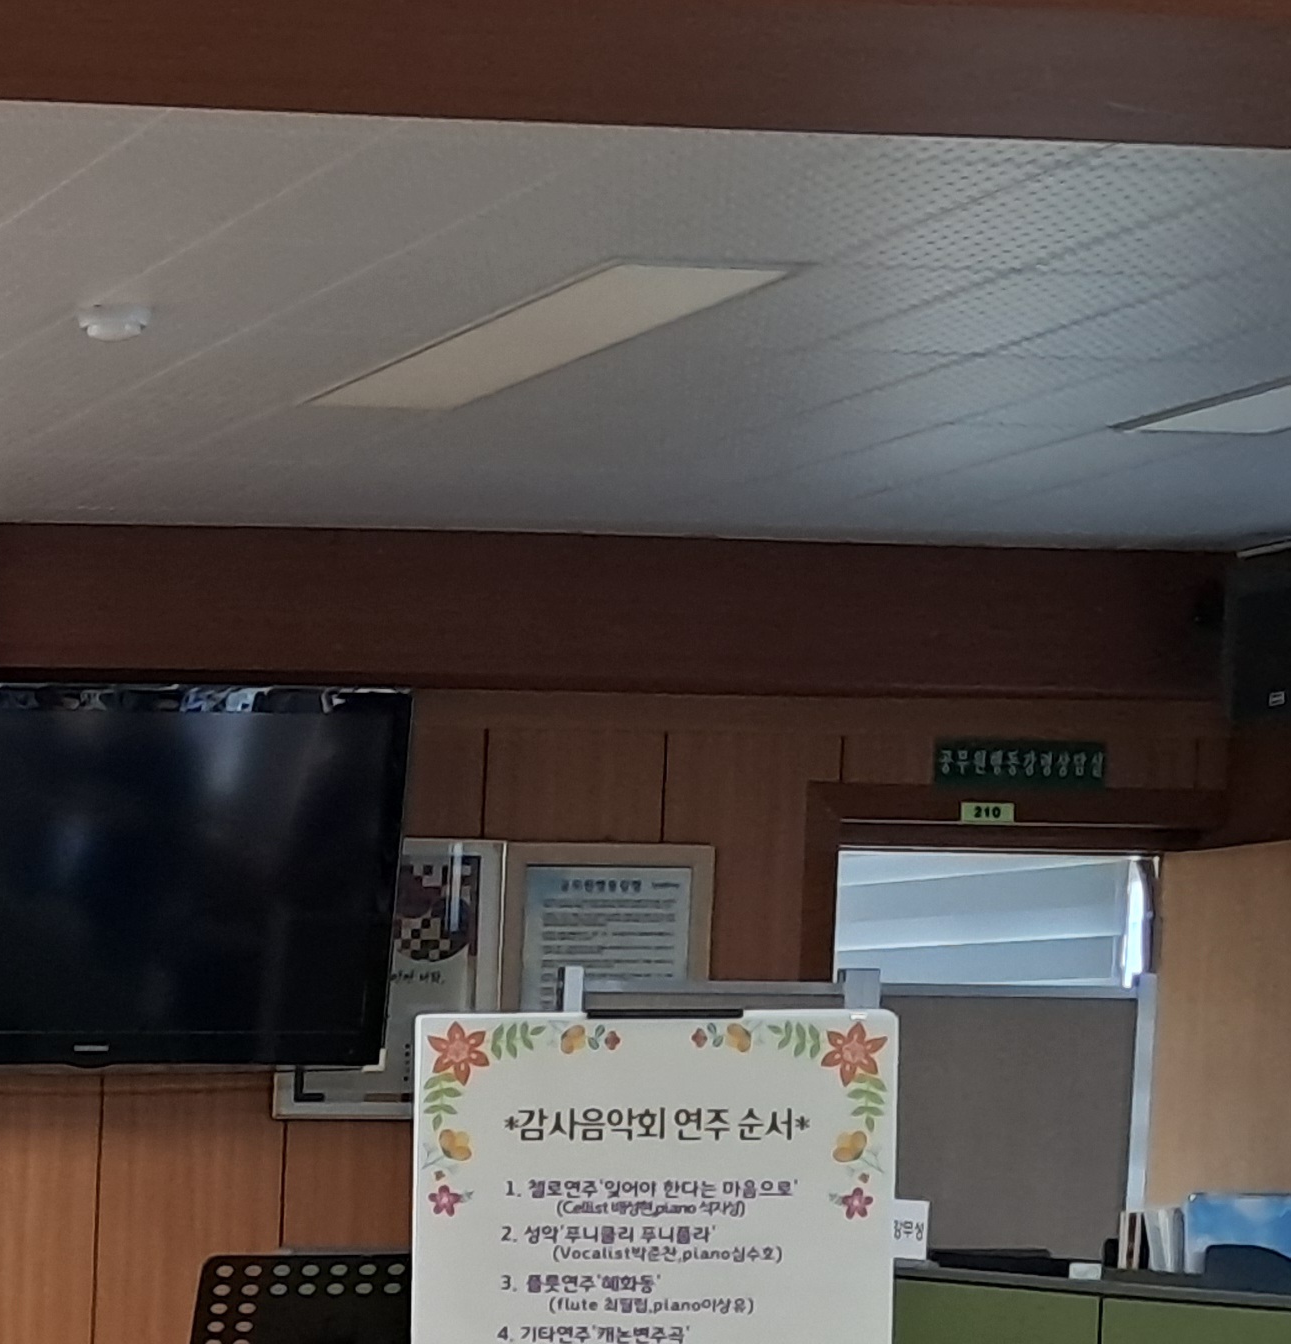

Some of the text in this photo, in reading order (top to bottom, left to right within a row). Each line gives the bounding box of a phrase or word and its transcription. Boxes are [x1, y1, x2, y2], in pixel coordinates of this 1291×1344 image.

[940, 748, 1104, 778] 공무원행동강령상담실
[974, 805, 1001, 819] 210
[673, 1107, 730, 1142] 연주
[505, 1180, 522, 1198] 1.
[663, 1179, 717, 1199] 한다는
[500, 1226, 518, 1243] 2.
[500, 1274, 518, 1293] 3.
[548, 1297, 599, 1315] (flute
[497, 1326, 514, 1343] 4.
